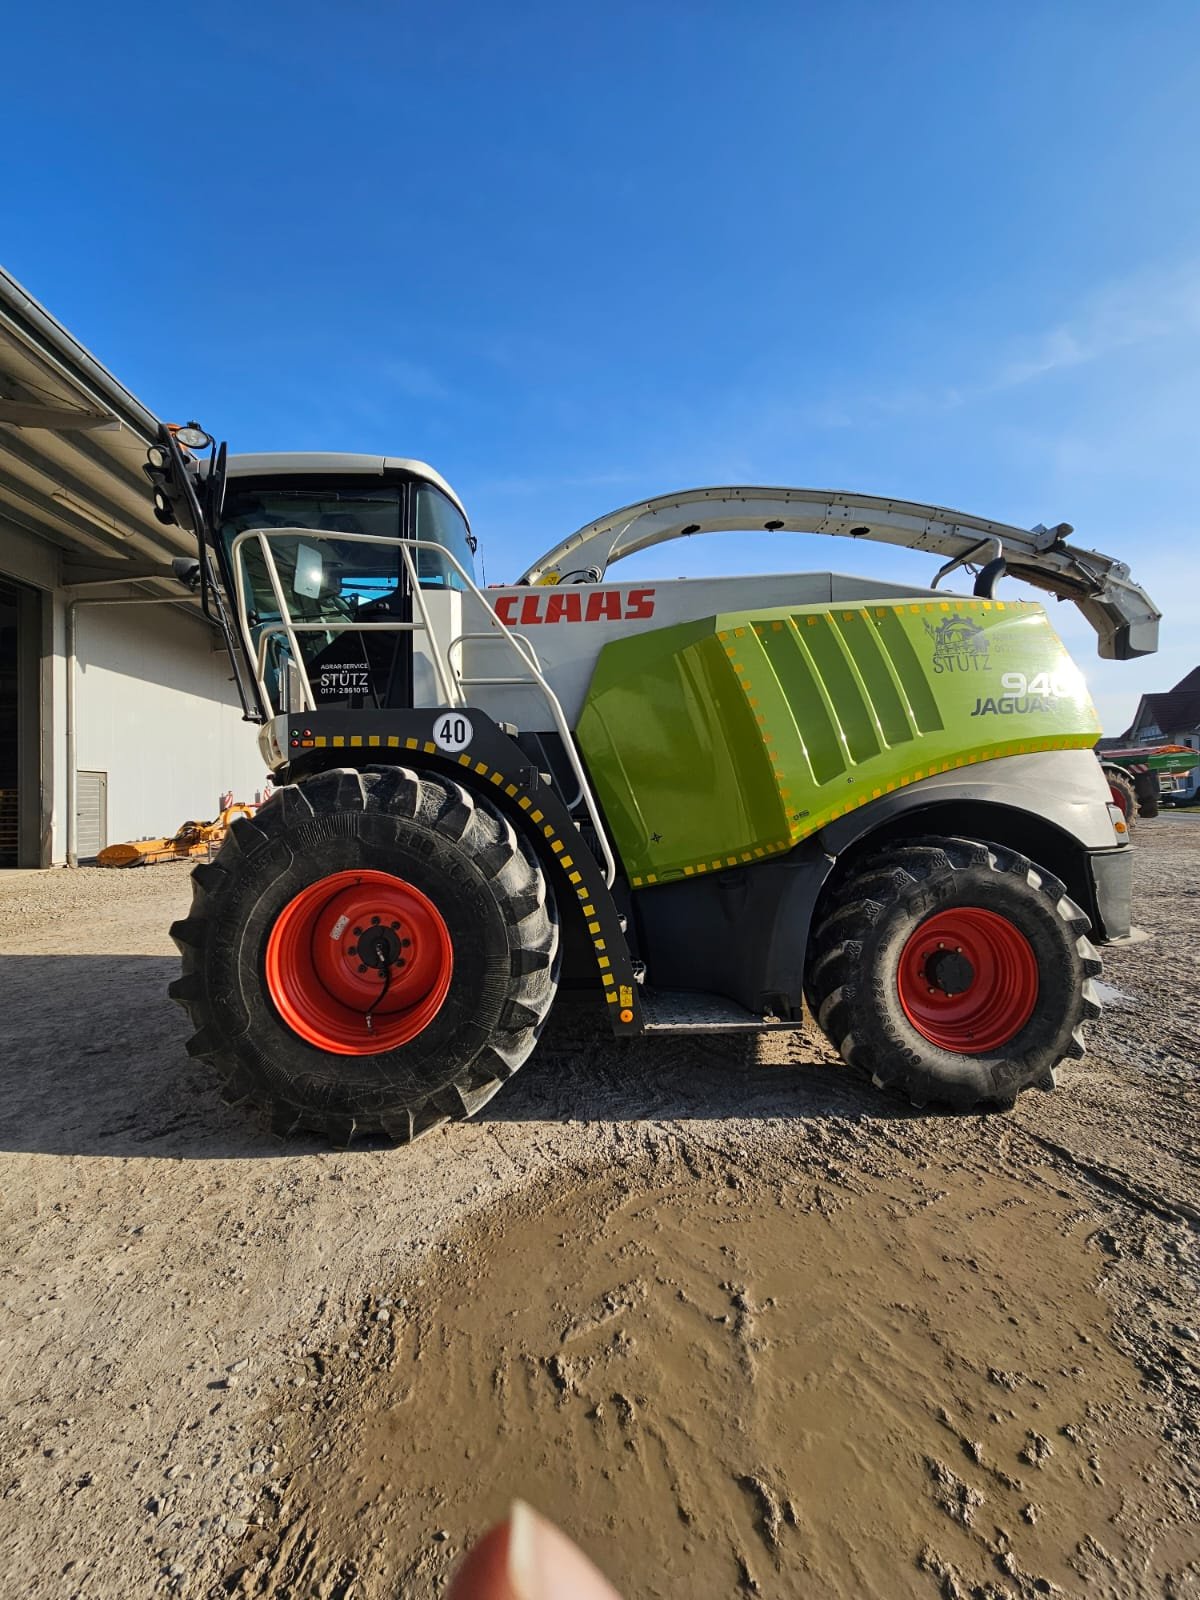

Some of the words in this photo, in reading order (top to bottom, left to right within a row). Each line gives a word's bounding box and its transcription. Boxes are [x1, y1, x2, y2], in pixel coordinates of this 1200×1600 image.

[492, 589, 656, 626] CLAAS
[320, 670, 369, 686] STÜTZ
[439, 719, 466, 744] 40
